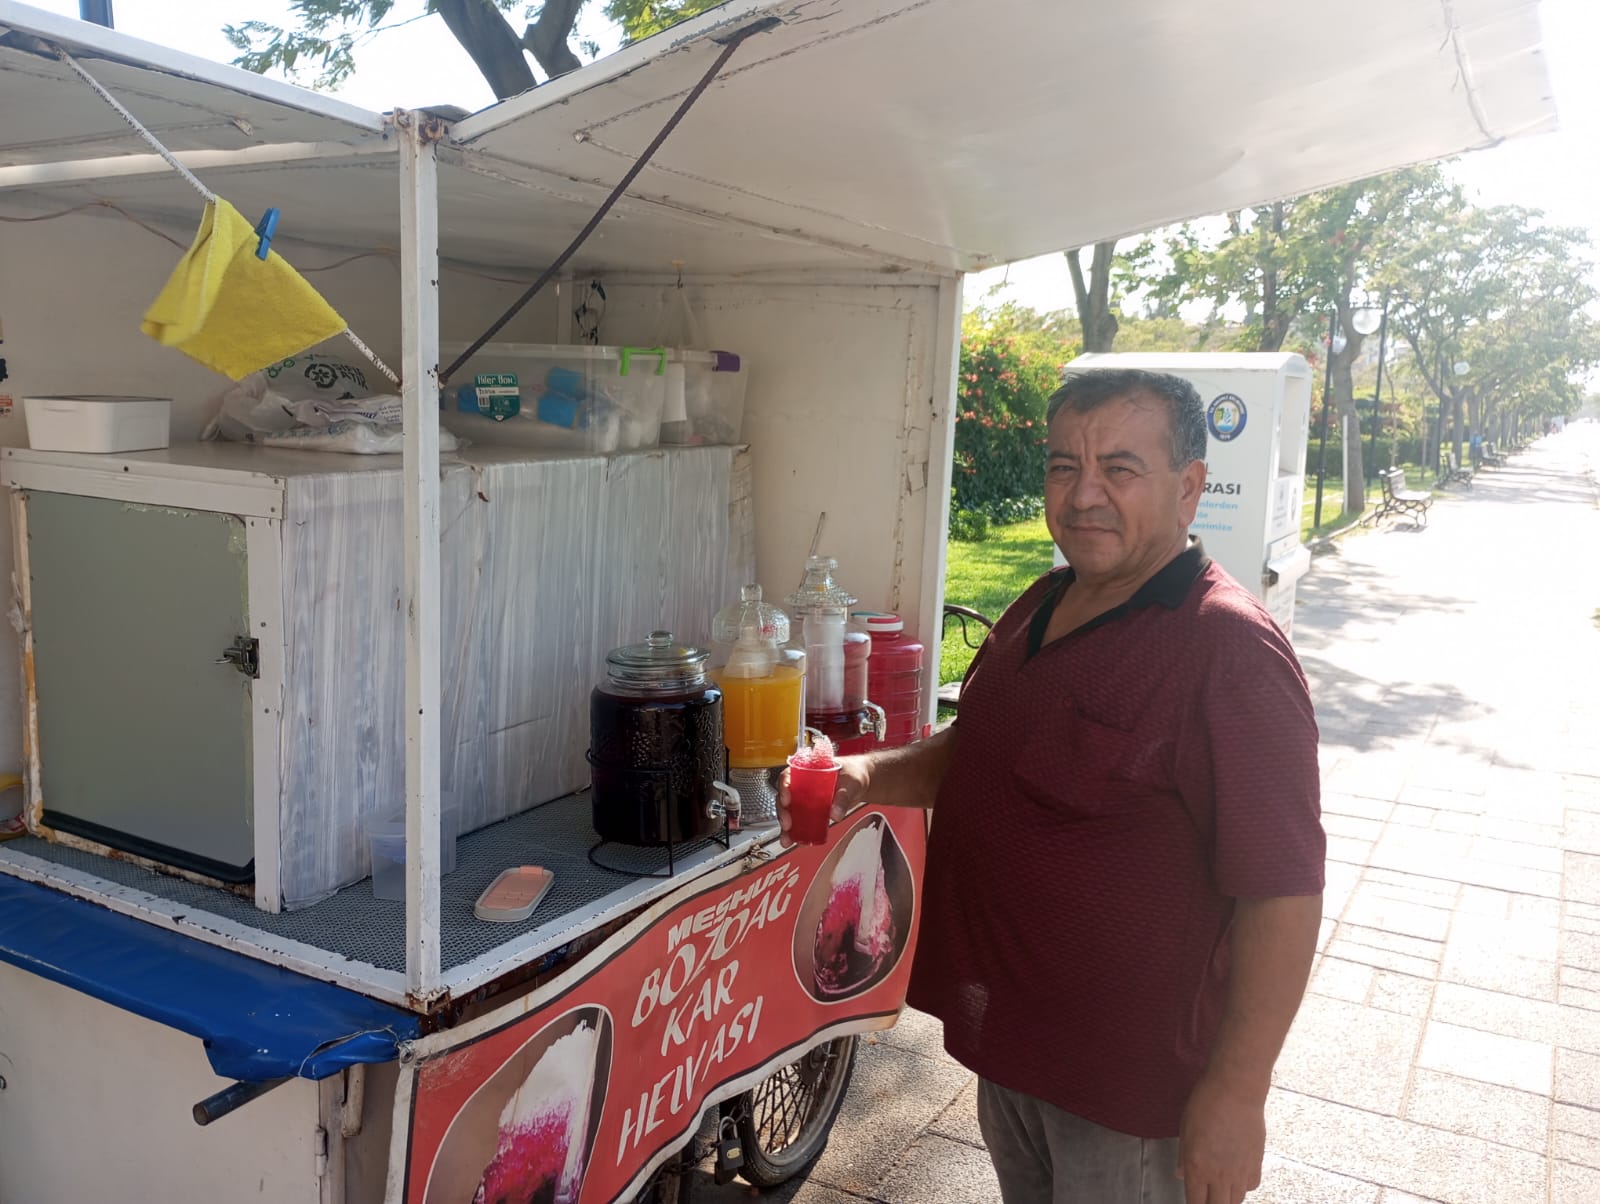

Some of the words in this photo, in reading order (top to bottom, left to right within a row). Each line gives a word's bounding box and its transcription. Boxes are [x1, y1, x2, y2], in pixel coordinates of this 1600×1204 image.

[1202, 482, 1241, 495] RASI
[661, 959, 740, 1057] KAR
[616, 995, 764, 1167] HELVASI
